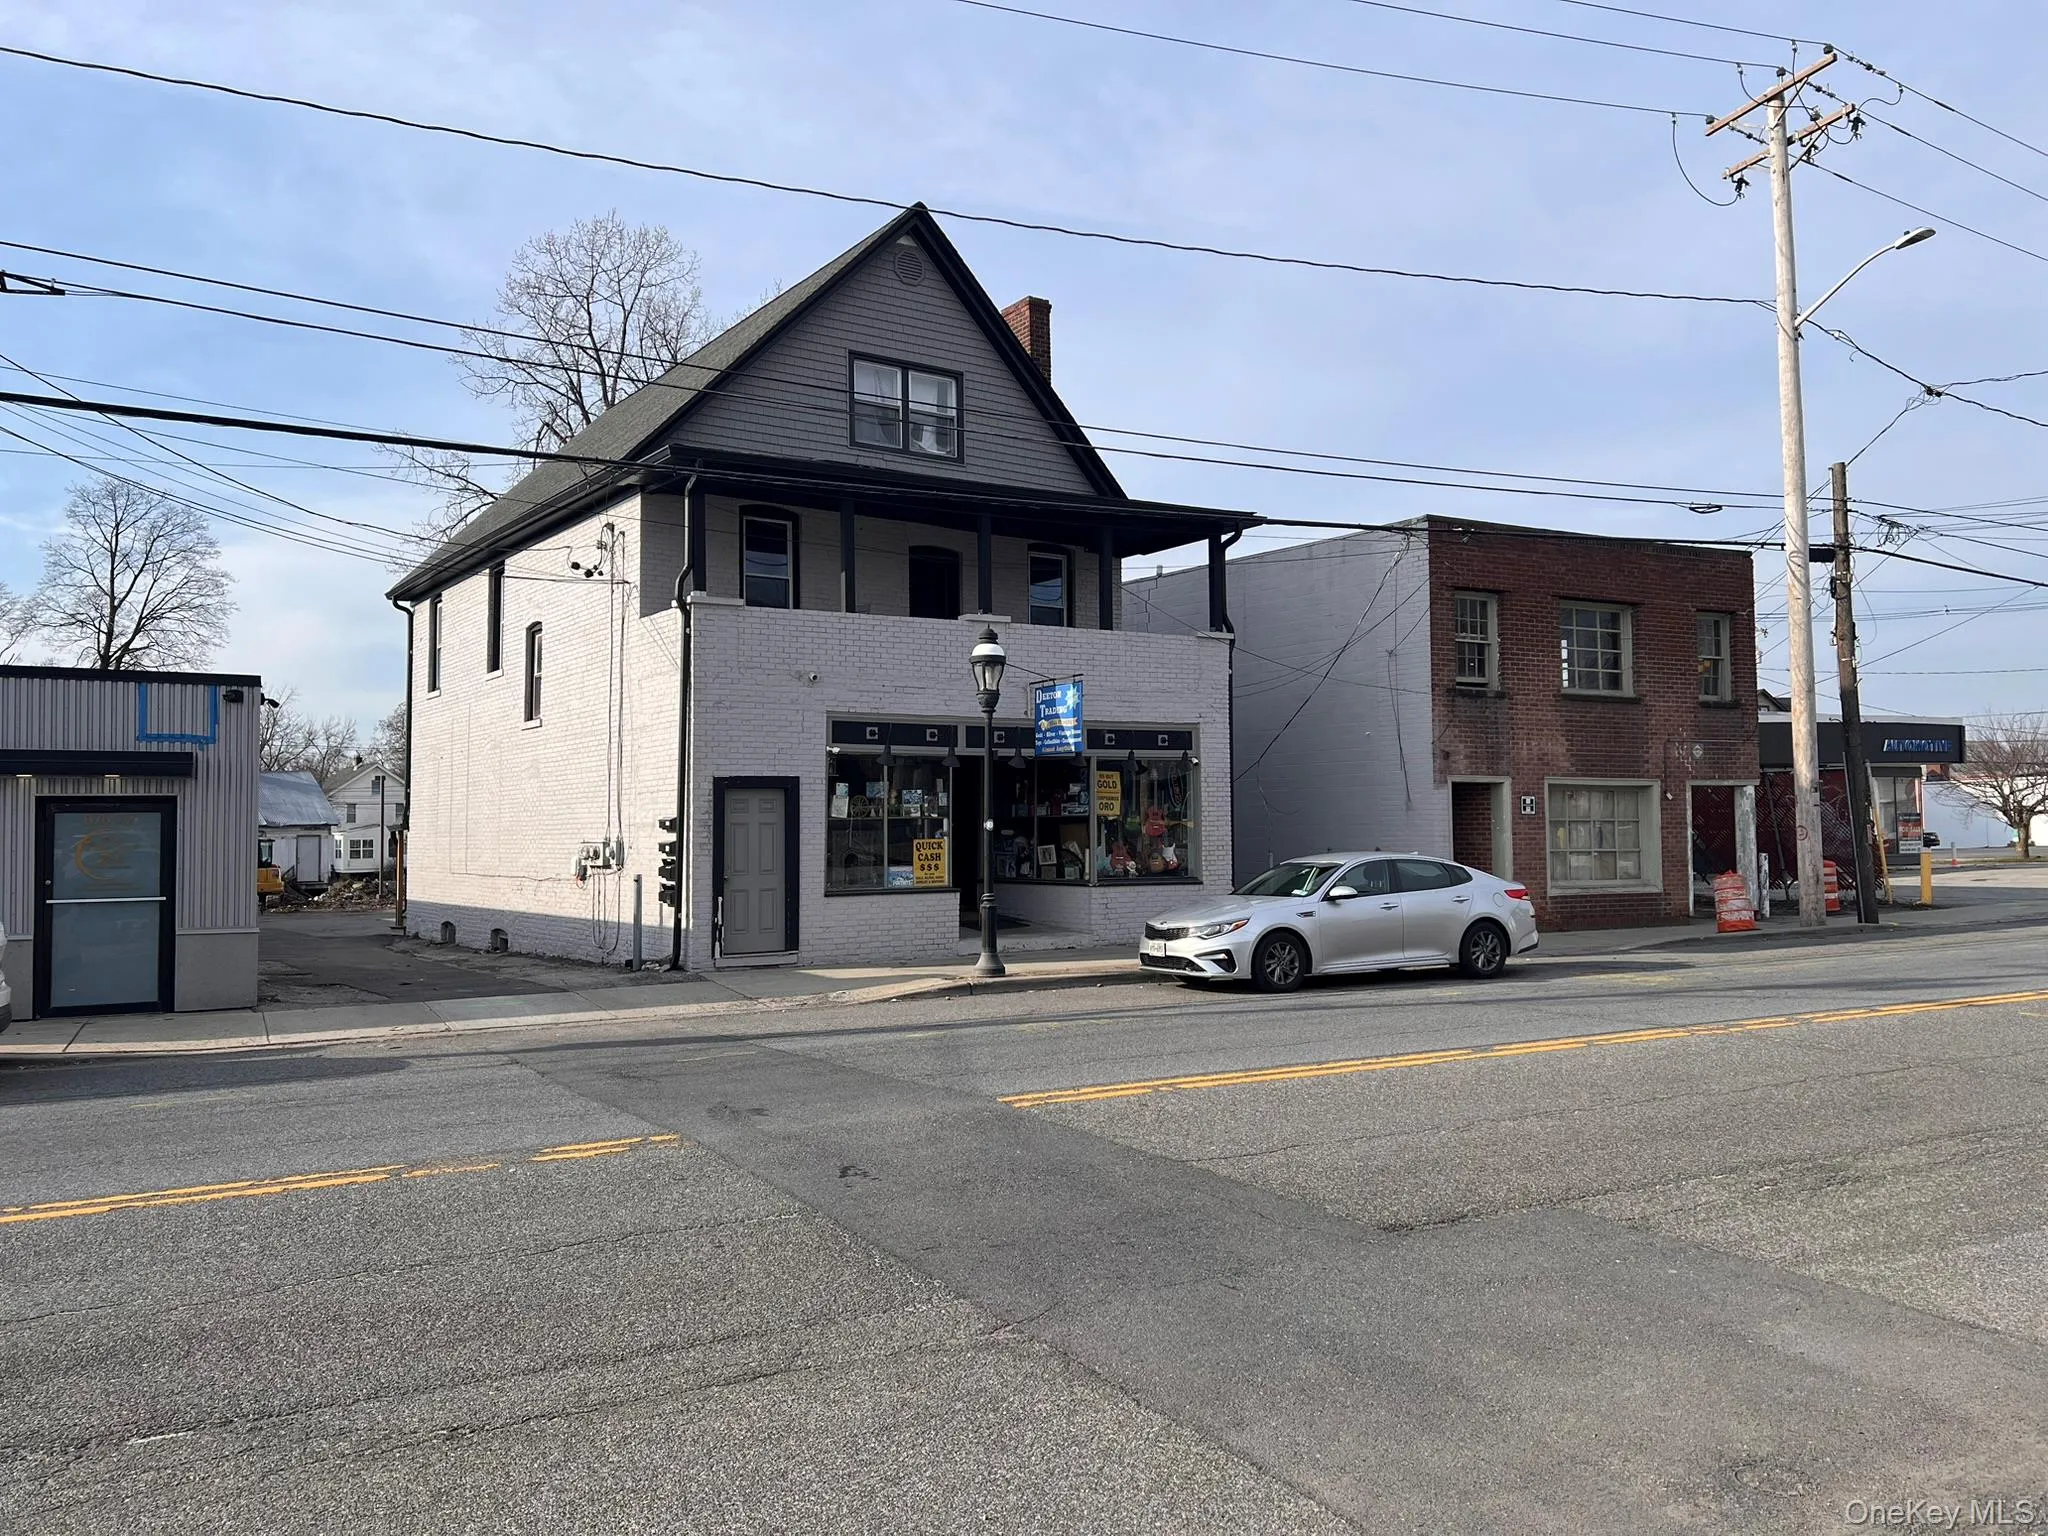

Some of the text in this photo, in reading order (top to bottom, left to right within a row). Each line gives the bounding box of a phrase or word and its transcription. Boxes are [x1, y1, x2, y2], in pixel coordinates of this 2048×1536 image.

[1040, 705, 1068, 718] TRADING
[1883, 739, 1952, 752] AUTOMOTIVE
[1097, 780, 1117, 789] GOLD
[1099, 802, 1114, 811] ORO
[916, 841, 943, 852] QUICK
[918, 853, 941, 861] CASH
